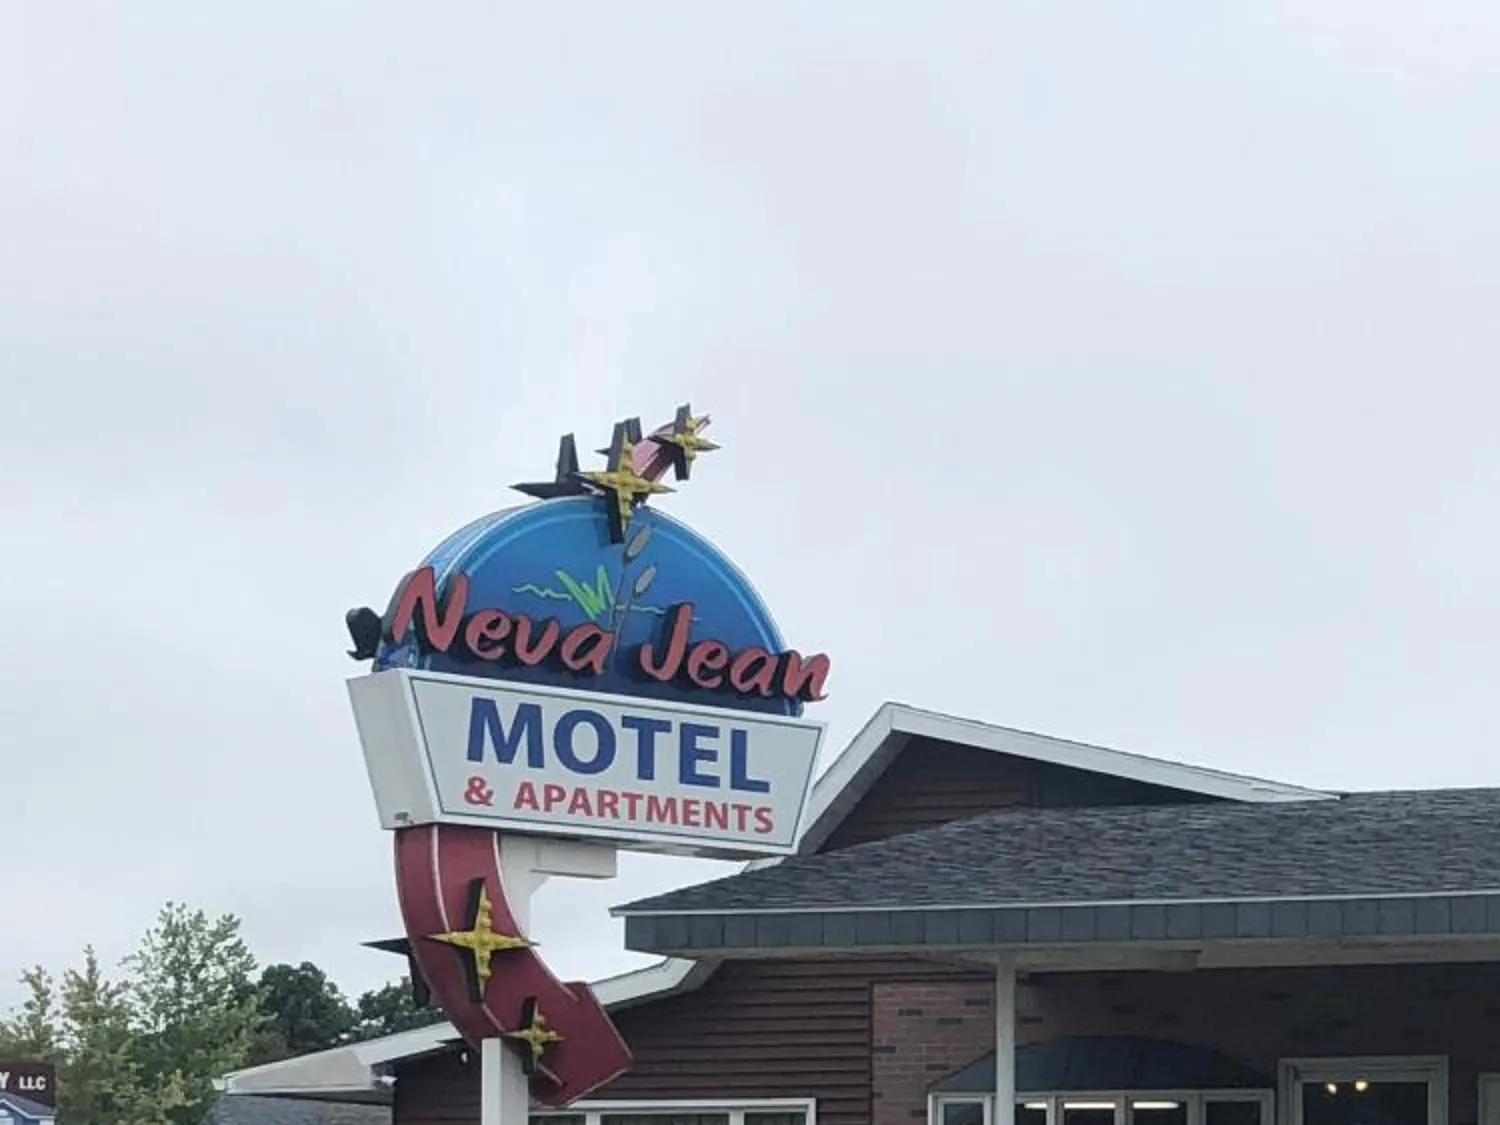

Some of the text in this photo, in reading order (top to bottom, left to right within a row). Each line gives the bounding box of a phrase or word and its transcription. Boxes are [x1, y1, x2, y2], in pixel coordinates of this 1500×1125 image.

[391, 565, 829, 702] Neva Jean
[466, 696, 771, 794] MOTEL
[463, 775, 775, 835] & APARTMENTS
[19, 1075, 46, 1091] LLC
